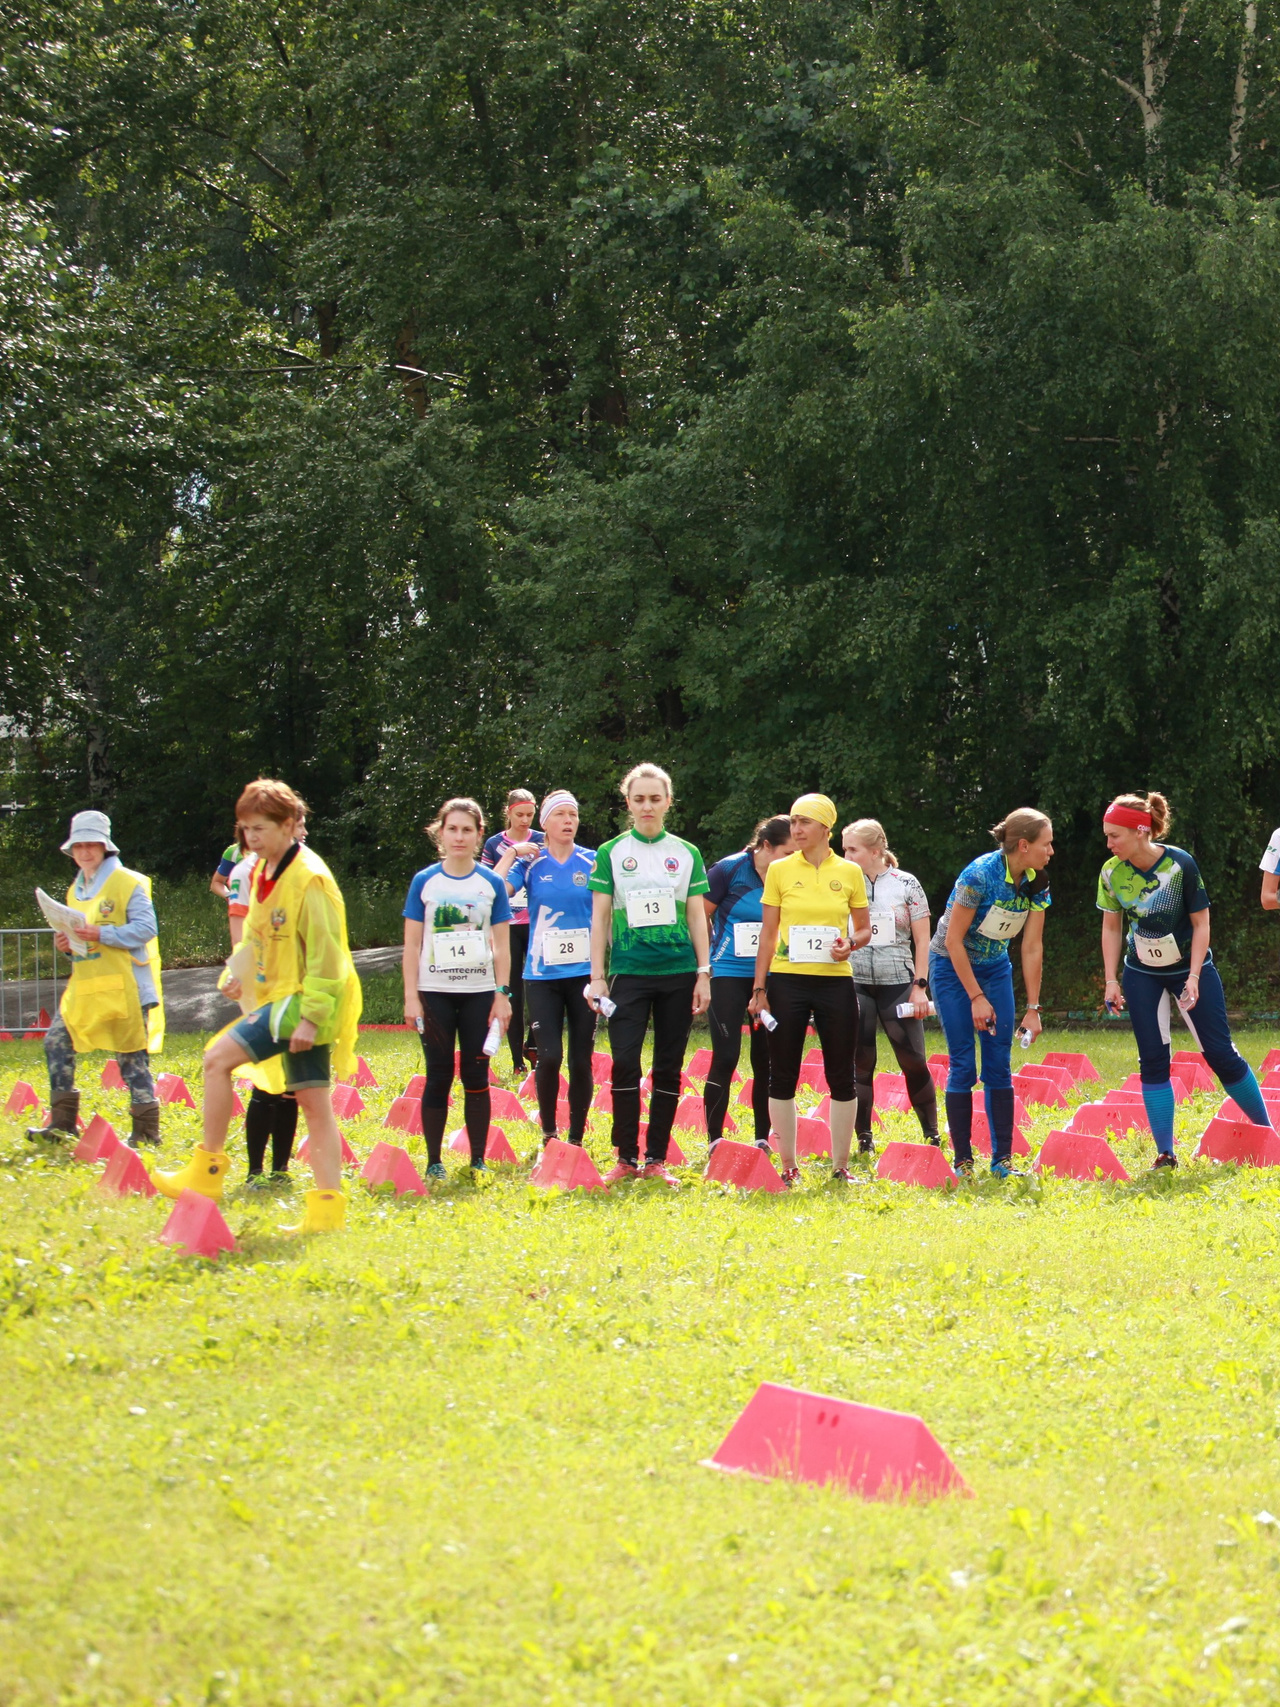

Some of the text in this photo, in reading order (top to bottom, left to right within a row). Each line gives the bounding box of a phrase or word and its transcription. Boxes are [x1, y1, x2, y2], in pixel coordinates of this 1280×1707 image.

[644, 902, 660, 914] 13
[998, 921, 1012, 932] 11
[559, 943, 574, 954] 28
[807, 939, 823, 951] 12
[450, 945, 466, 957] 14
[1147, 948, 1163, 958] 10
